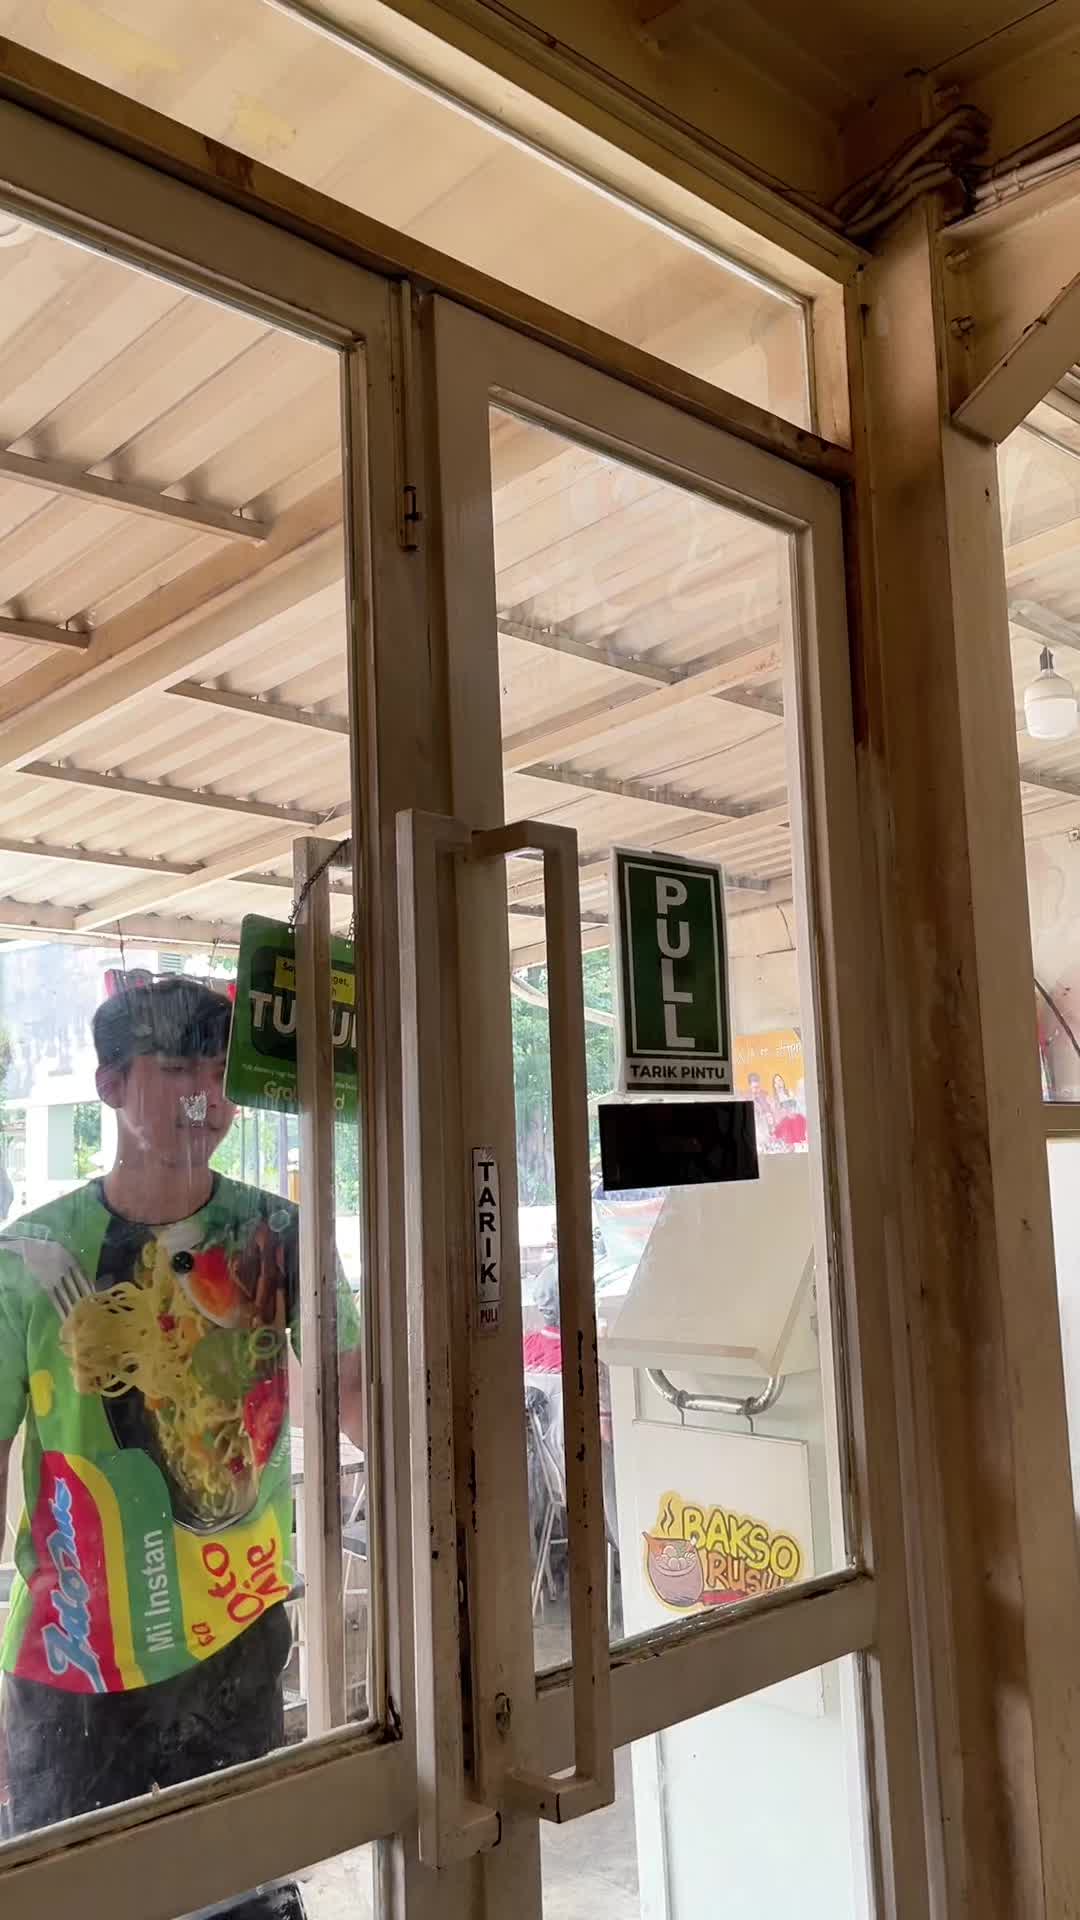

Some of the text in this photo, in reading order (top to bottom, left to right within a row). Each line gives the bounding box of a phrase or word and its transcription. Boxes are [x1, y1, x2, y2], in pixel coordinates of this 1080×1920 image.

[655, 875, 696, 1049] PULL
[630, 1064, 725, 1080] TARIK PINTU
[478, 1161, 498, 1285] TARIK
[141, 1529, 175, 1653] Mi Instan
[682, 1506, 800, 1579] BAKSO
